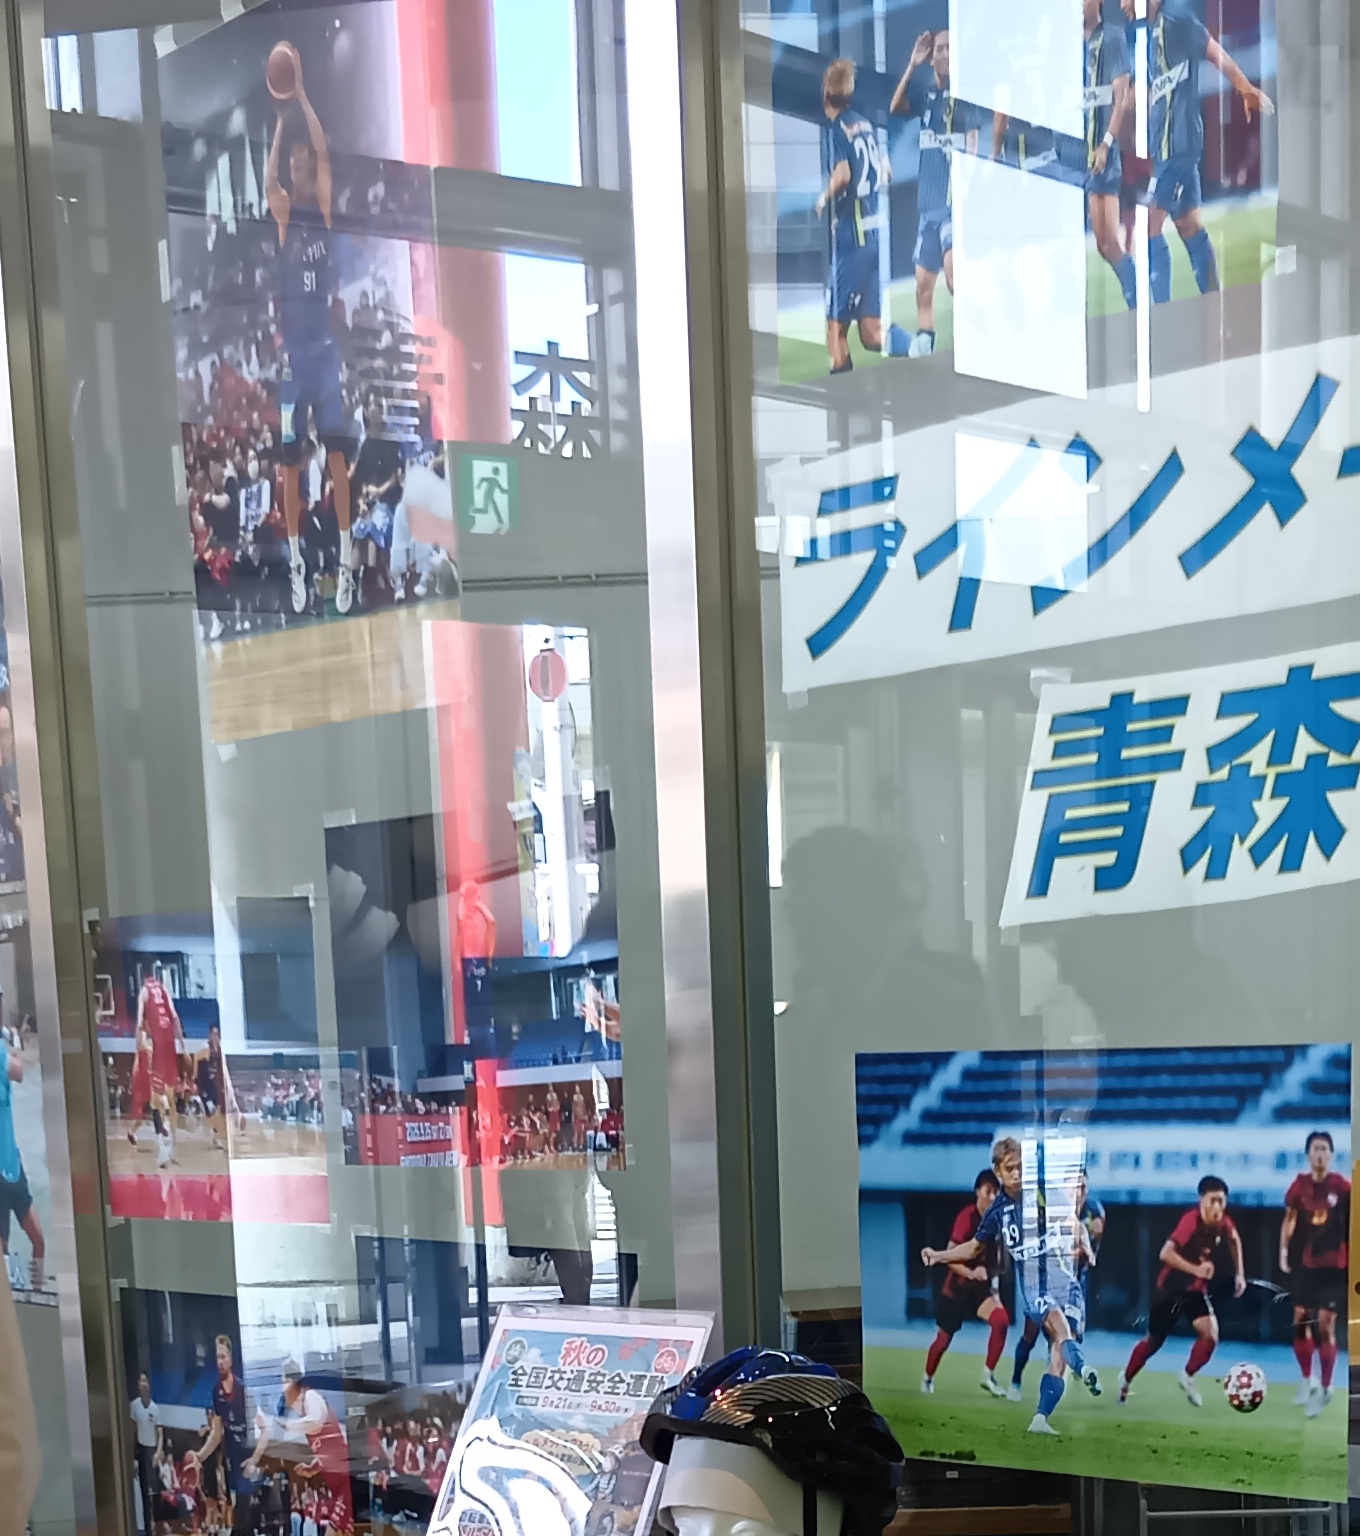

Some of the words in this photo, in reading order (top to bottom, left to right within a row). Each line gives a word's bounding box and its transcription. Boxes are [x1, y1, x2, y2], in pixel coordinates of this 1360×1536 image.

[560, 1338, 608, 1368] 秋の
[508, 1364, 667, 1399] 全国交通安全運動
